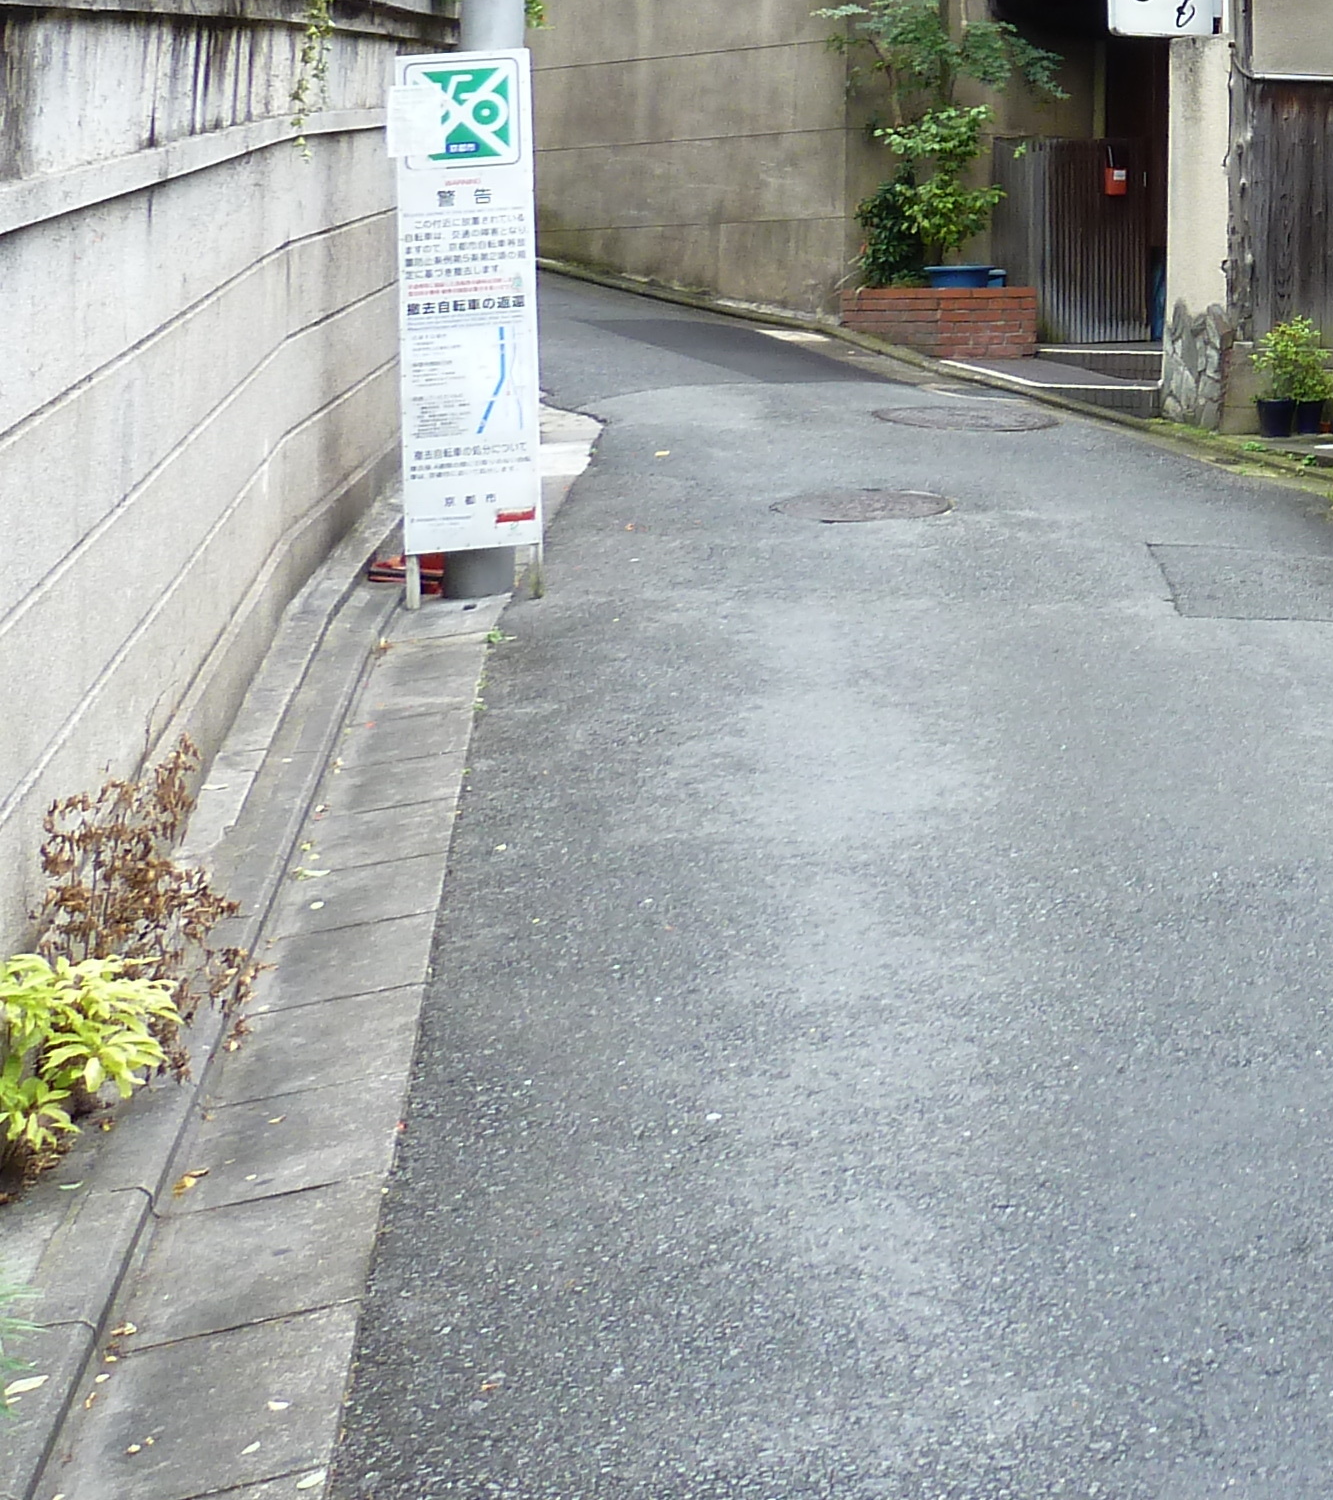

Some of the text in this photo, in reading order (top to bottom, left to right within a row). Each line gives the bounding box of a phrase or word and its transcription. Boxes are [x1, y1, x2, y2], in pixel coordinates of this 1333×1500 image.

[437, 188, 492, 207] 警告
[406, 296, 525, 316] 撤去自転車の返還
